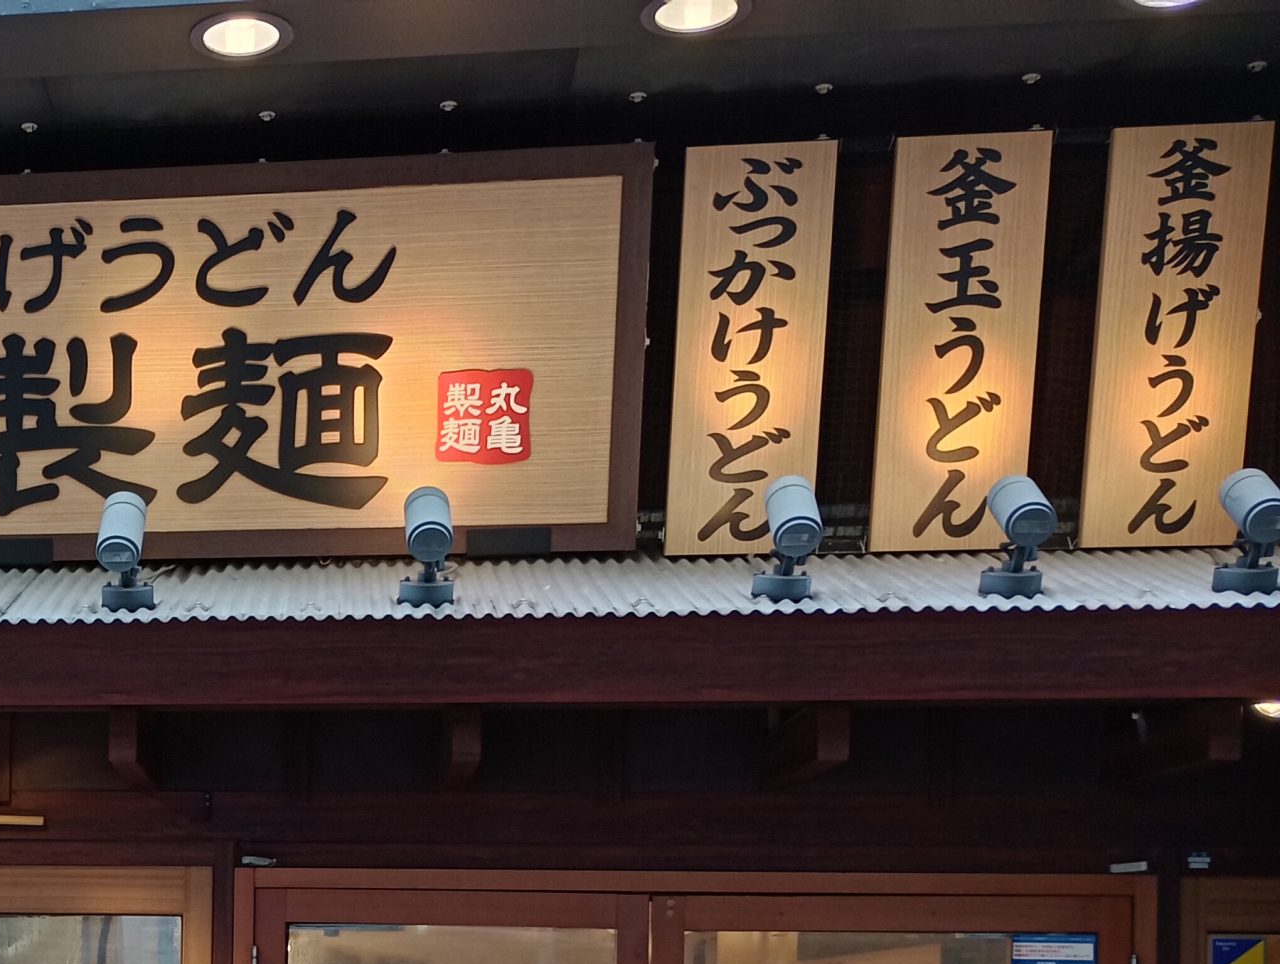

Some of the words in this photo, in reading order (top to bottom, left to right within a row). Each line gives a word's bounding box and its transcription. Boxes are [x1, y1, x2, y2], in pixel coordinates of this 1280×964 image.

[697, 157, 803, 542] ぶっかけうどん
[912, 147, 1017, 538] 釜玉うどん
[1128, 138, 1232, 535] 釜揚げうどん
